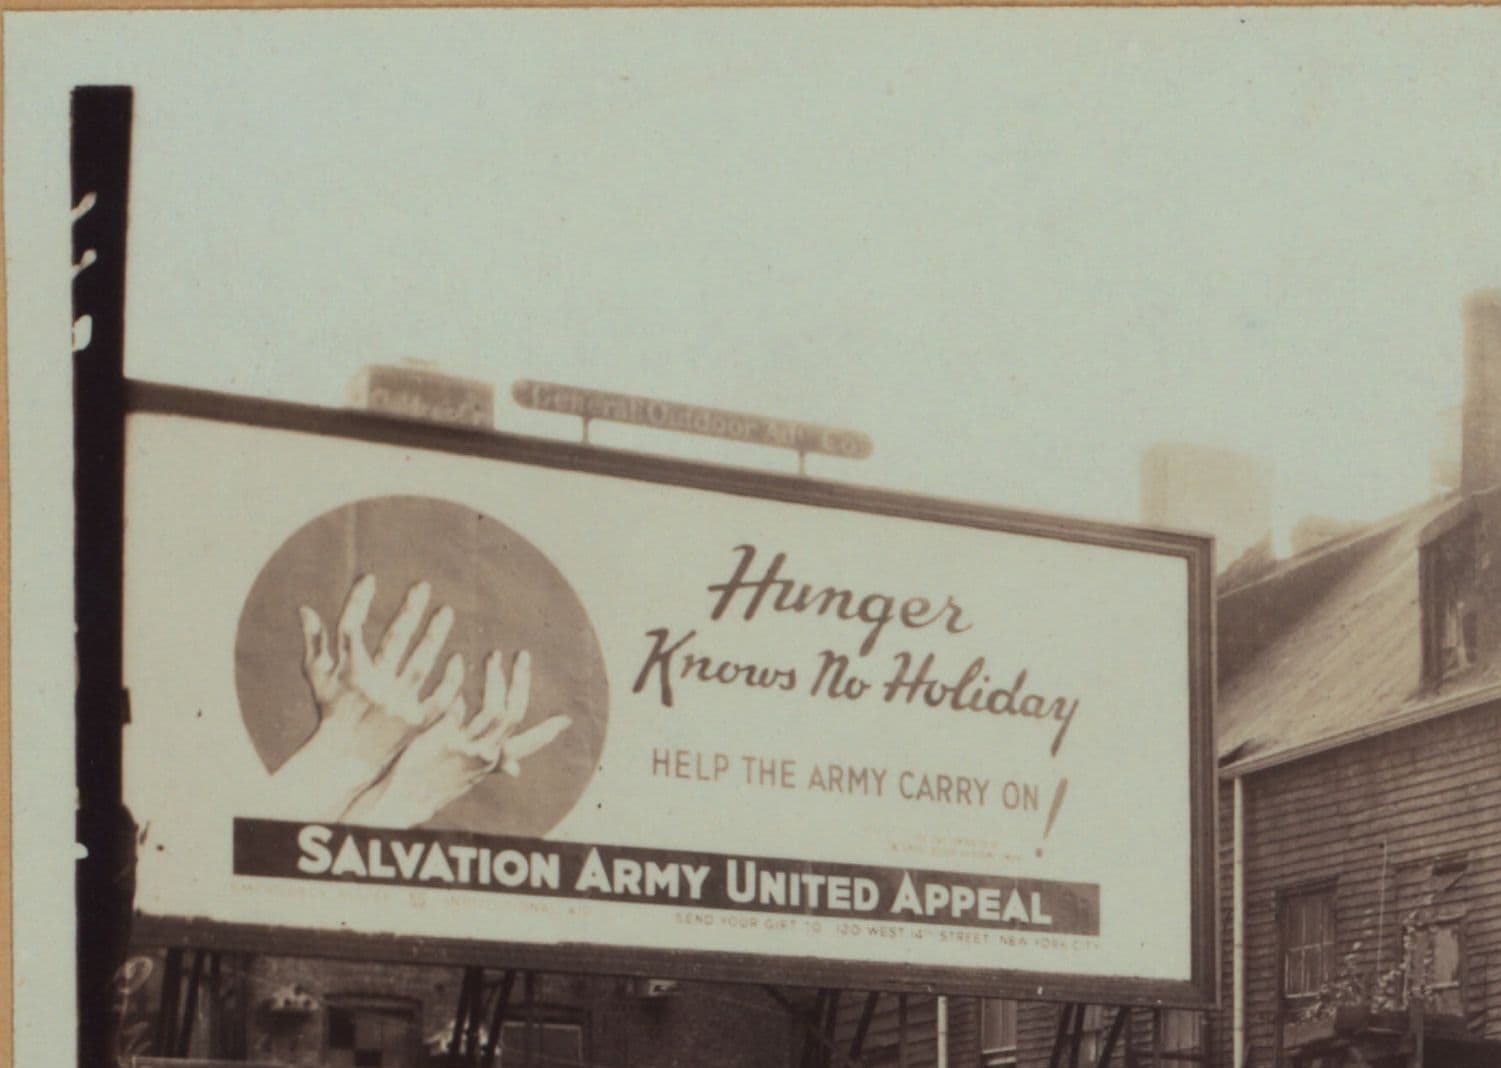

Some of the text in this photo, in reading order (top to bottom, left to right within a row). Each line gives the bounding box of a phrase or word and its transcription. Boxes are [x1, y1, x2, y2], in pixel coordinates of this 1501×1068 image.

[531, 383, 638, 421] General
[647, 402, 757, 438] Outdoor
[707, 543, 973, 657] Hunger
[631, 628, 1081, 758] Knows No Holiday
[652, 748, 729, 783] HELP
[742, 756, 797, 789] THE
[807, 764, 888, 800] ARMY
[898, 771, 990, 808] CARRY
[296, 826, 1054, 927] SALVATION ARMY UNITED APPEAL
[867, 925, 905, 939] WEST
[939, 929, 990, 946] STREET
